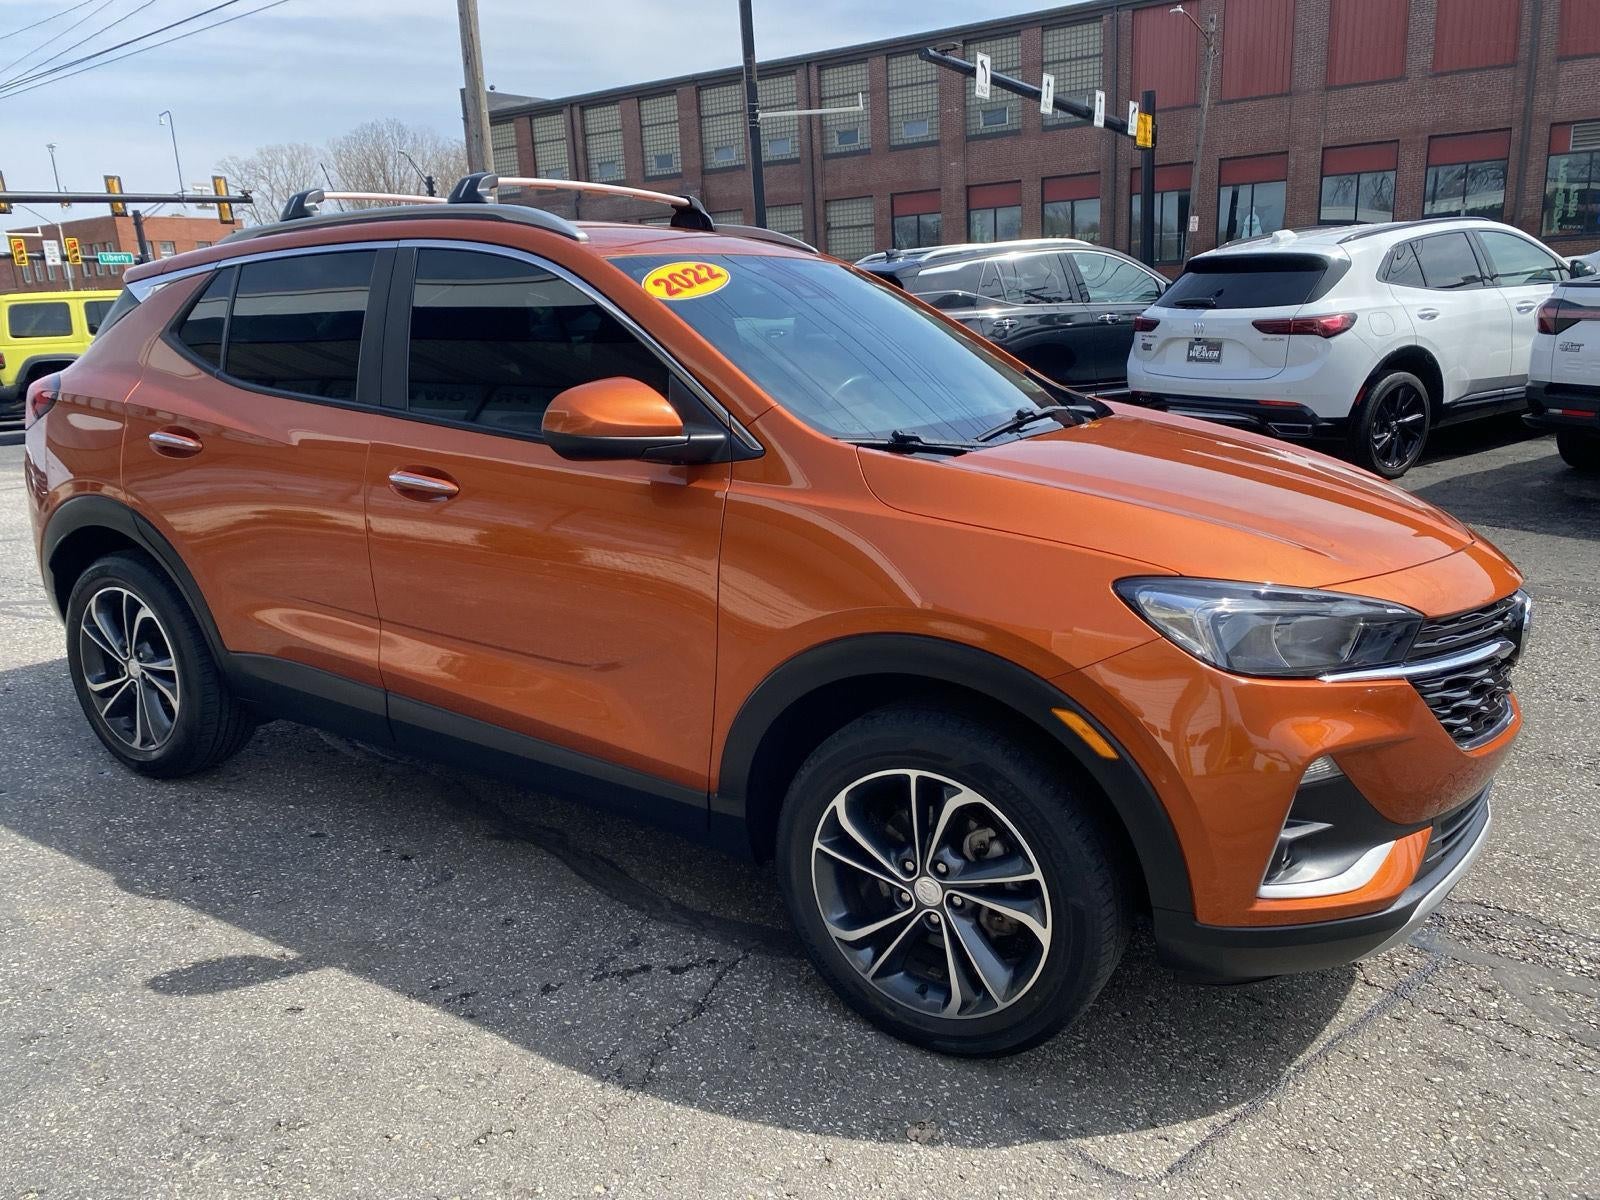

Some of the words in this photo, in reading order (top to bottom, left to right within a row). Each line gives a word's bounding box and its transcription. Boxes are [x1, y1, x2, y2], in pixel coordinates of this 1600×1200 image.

[102, 254, 129, 263] Liberty
[653, 263, 722, 297] 2022
[1189, 350, 1220, 358] WEAVER
